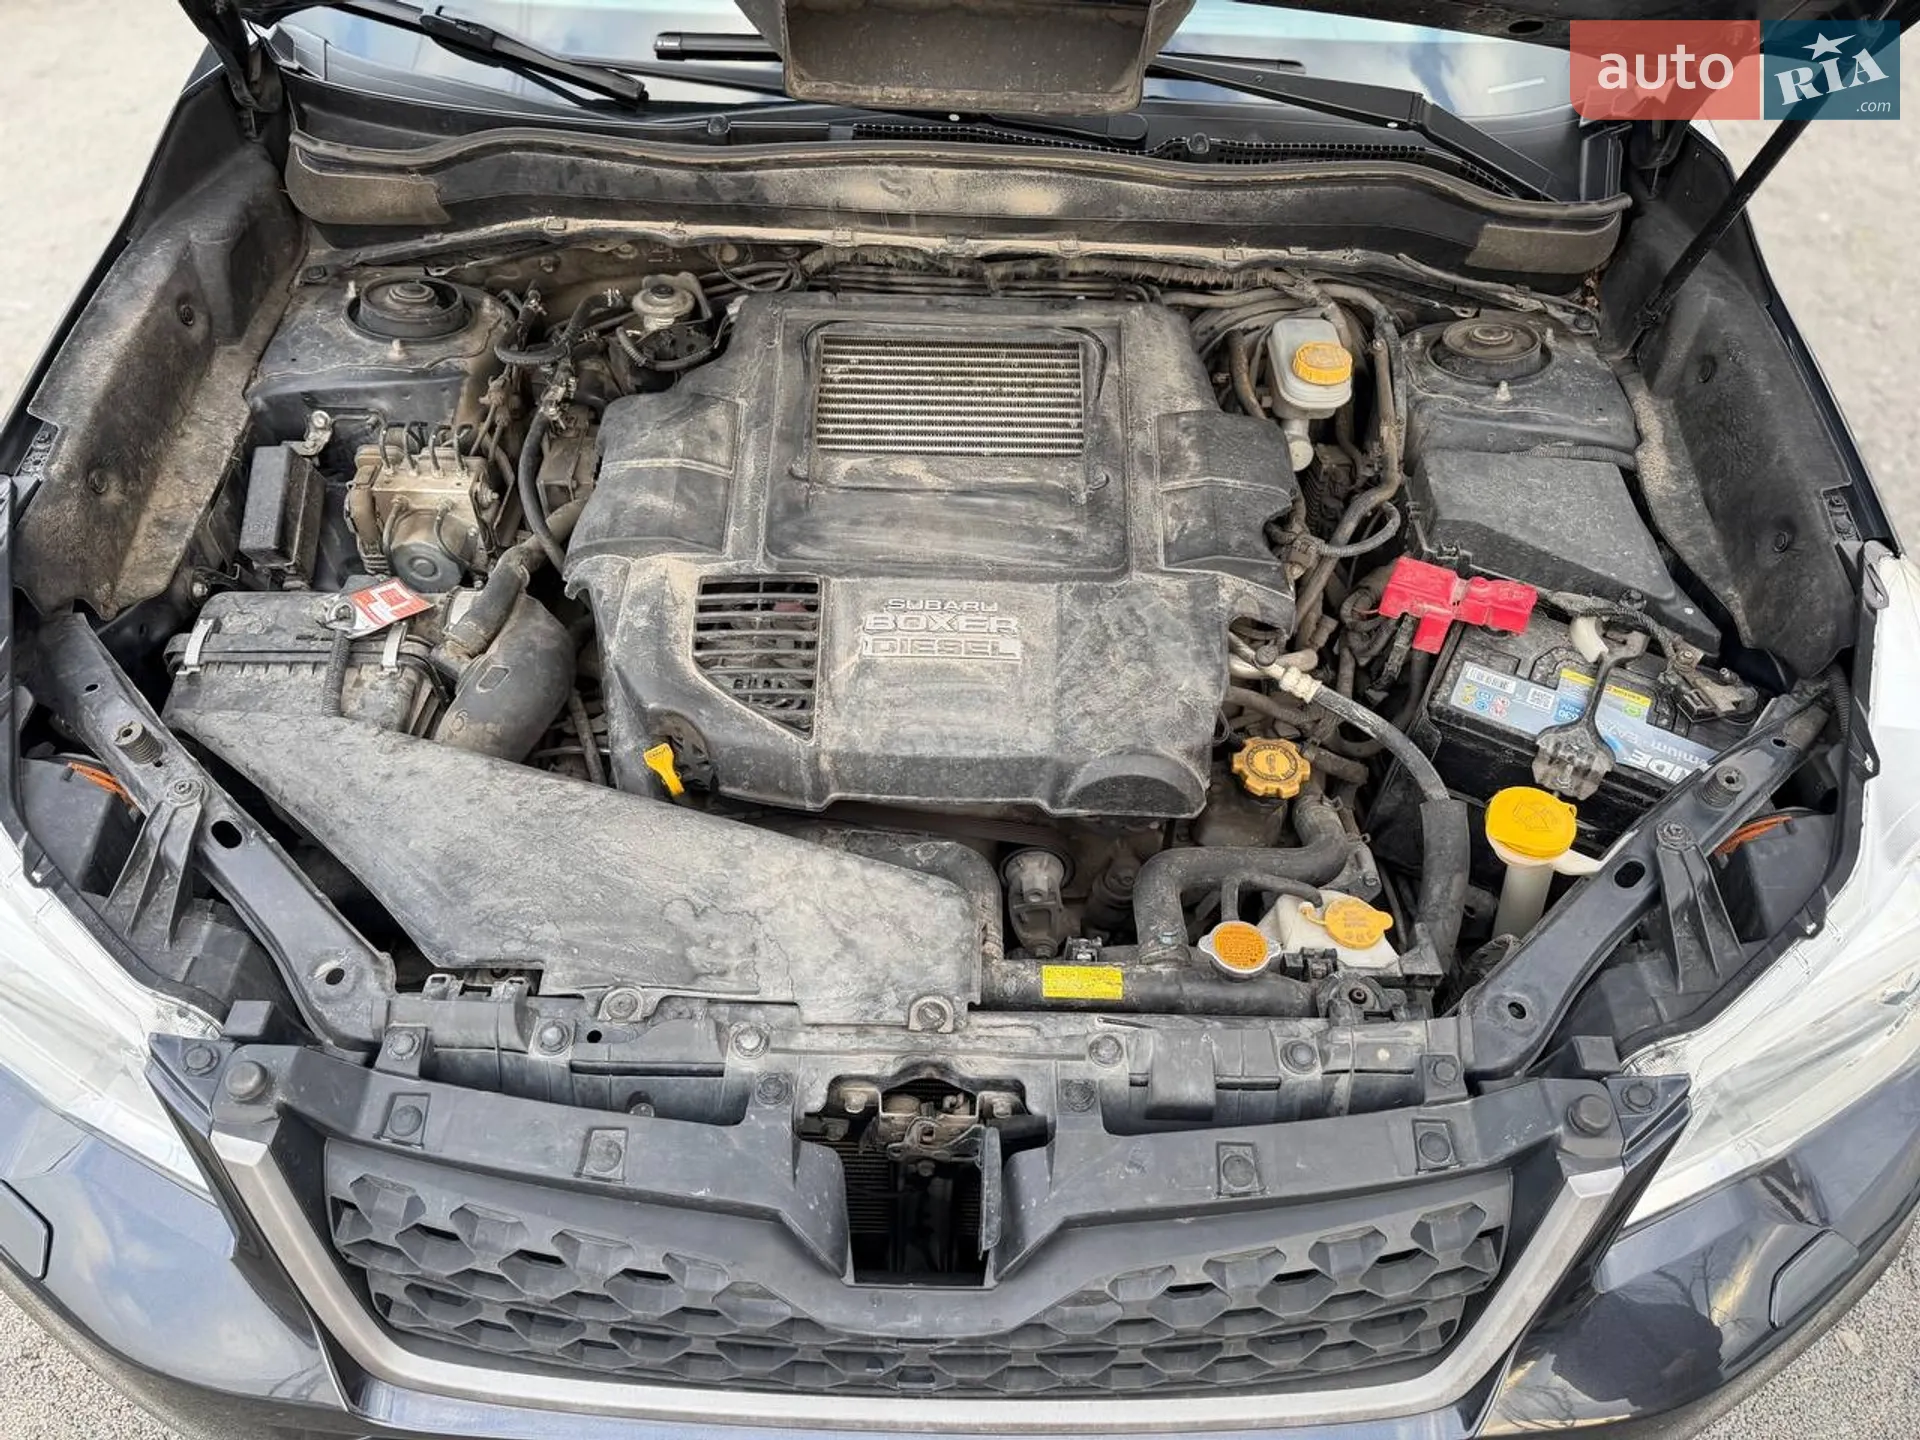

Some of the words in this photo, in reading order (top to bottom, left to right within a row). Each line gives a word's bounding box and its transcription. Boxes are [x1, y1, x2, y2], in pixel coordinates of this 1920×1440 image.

[886, 598, 998, 612] SUBARU
[864, 612, 1019, 635] BOXER
[865, 637, 1020, 661] DIESEL
